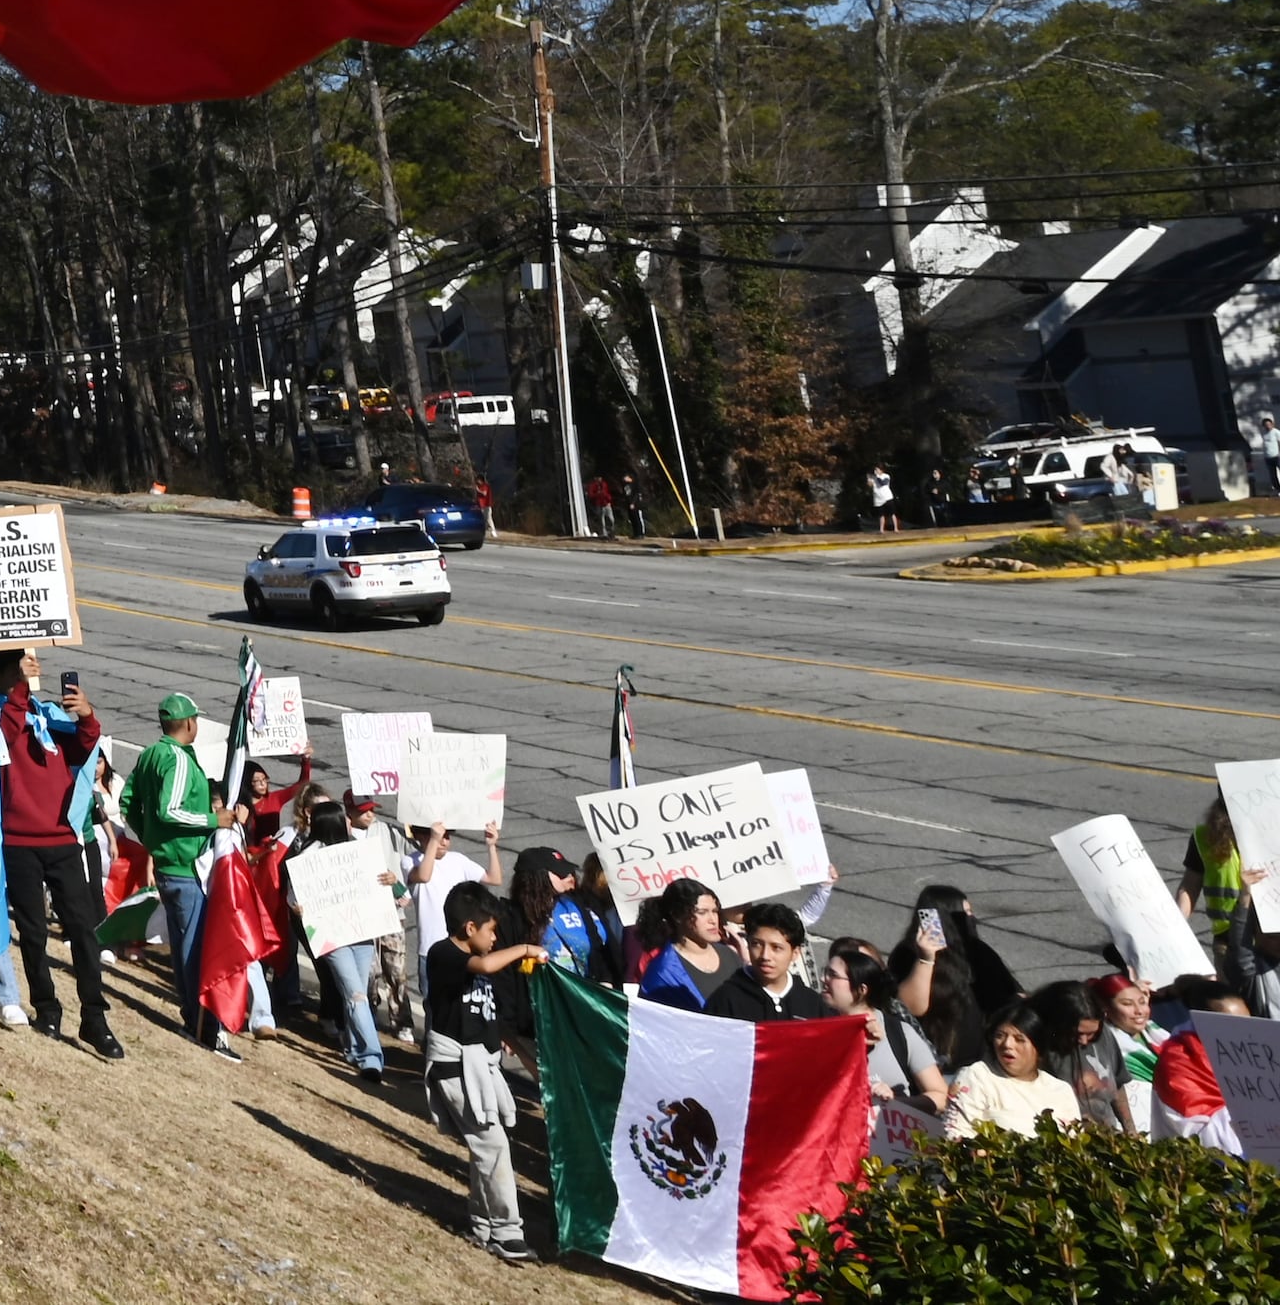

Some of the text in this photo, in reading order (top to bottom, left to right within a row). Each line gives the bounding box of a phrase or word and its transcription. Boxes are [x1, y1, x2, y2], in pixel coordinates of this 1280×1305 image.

[7, 558, 58, 575] CAUSE
[11, 577, 32, 588] THE
[588, 782, 736, 842] NO ONE
[611, 838, 654, 865] IS
[662, 821, 737, 855] Illegal
[559, 913, 582, 929] ES
